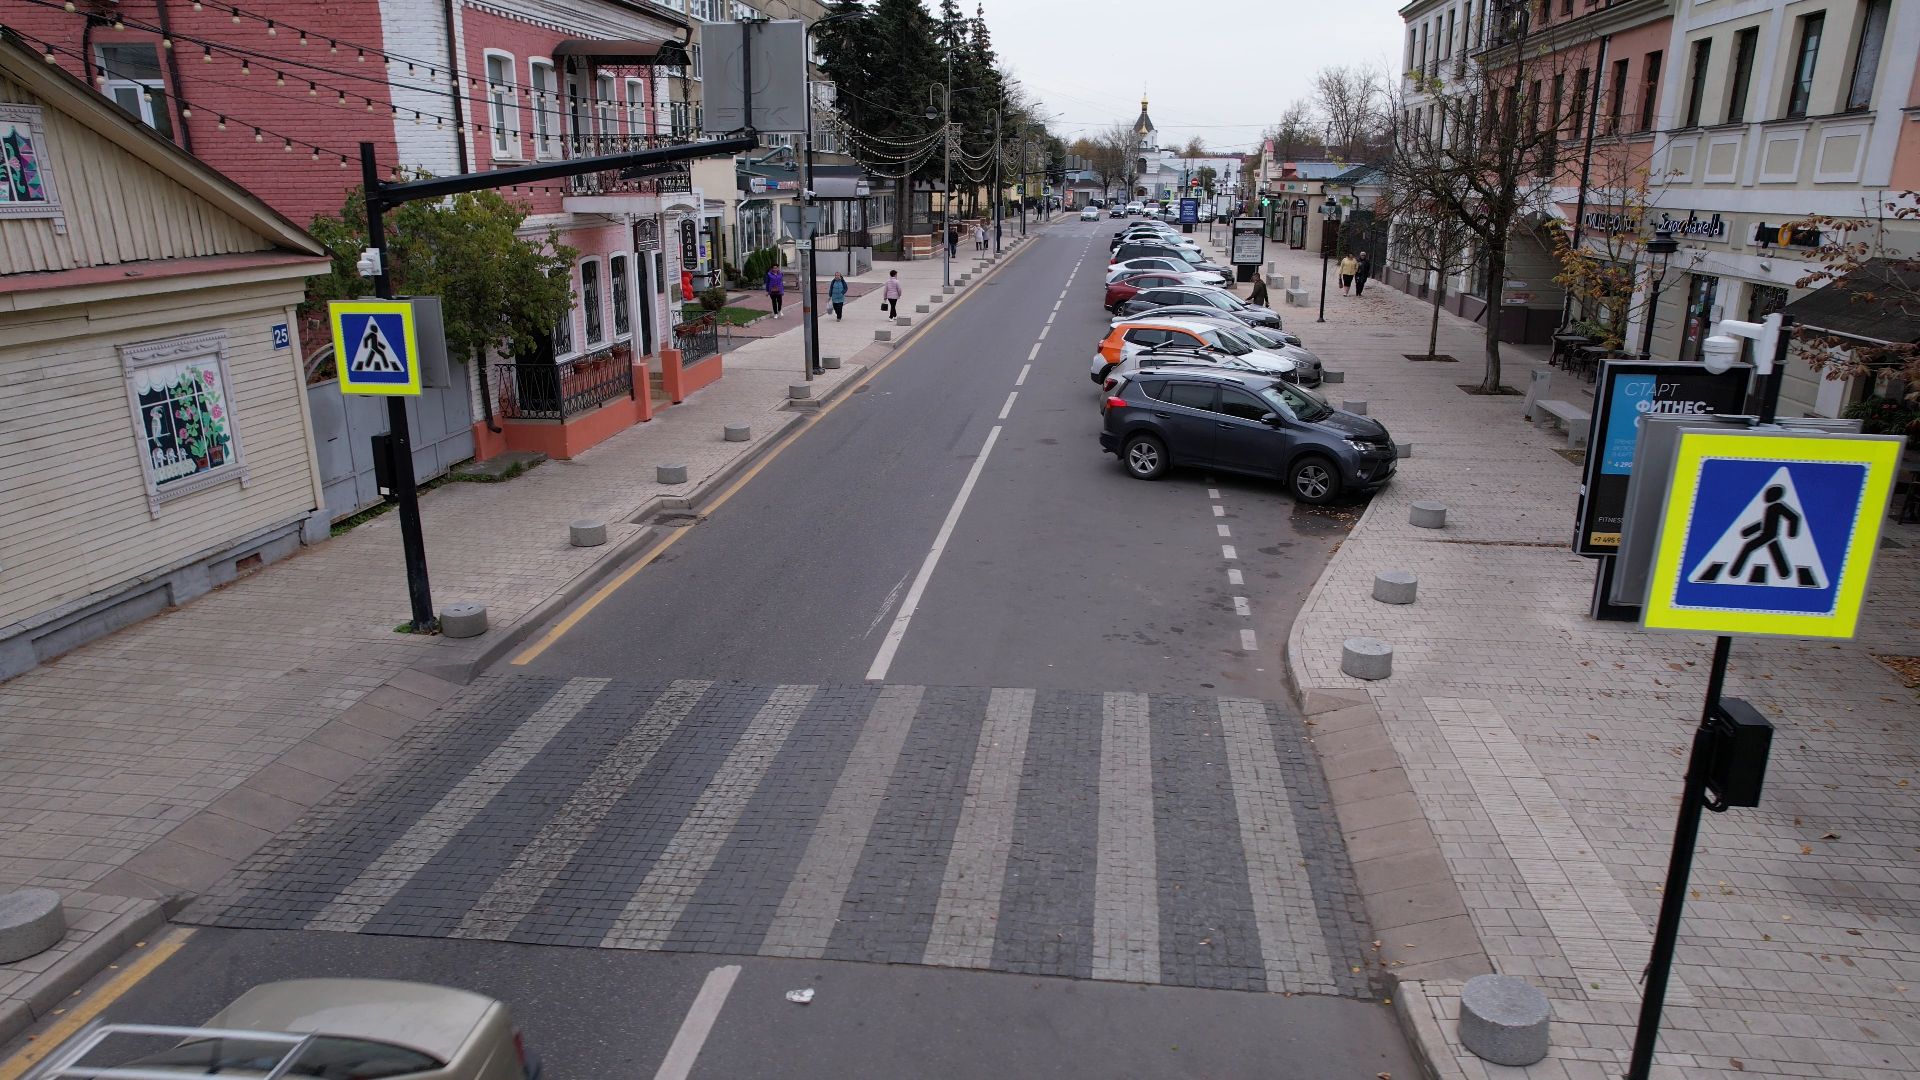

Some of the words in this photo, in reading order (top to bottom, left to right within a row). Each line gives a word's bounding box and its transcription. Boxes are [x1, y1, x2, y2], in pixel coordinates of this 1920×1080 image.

[274, 328, 287, 344] 25
[1625, 382, 1681, 397] СТАРТ
[1635, 400, 1715, 414] ФИТНЕС-
